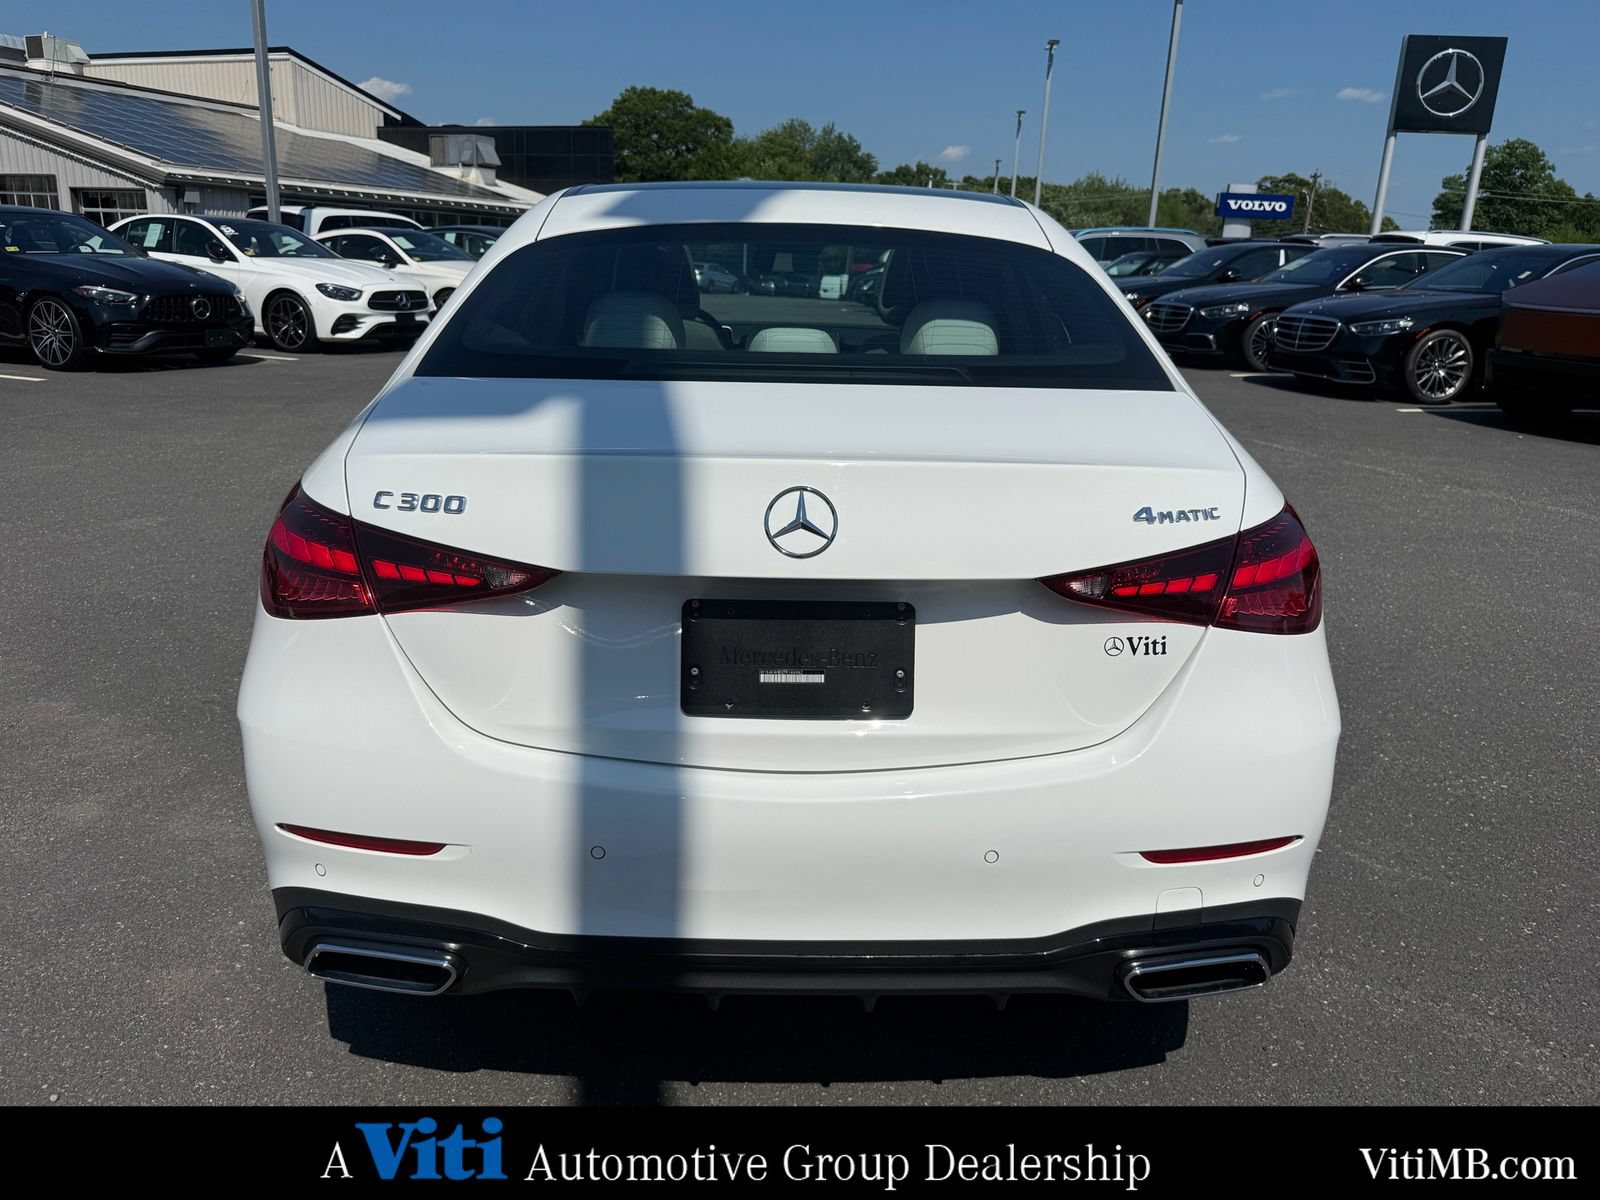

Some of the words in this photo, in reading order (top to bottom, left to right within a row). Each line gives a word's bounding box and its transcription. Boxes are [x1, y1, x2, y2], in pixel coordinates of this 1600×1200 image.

[1227, 199, 1287, 212] VOLVO
[373, 490, 394, 509] C
[397, 492, 467, 514] 300
[1133, 506, 1220, 524] 4MATIC
[1126, 635, 1167, 656] Viti
[718, 646, 879, 668] Mercedes-Benz
